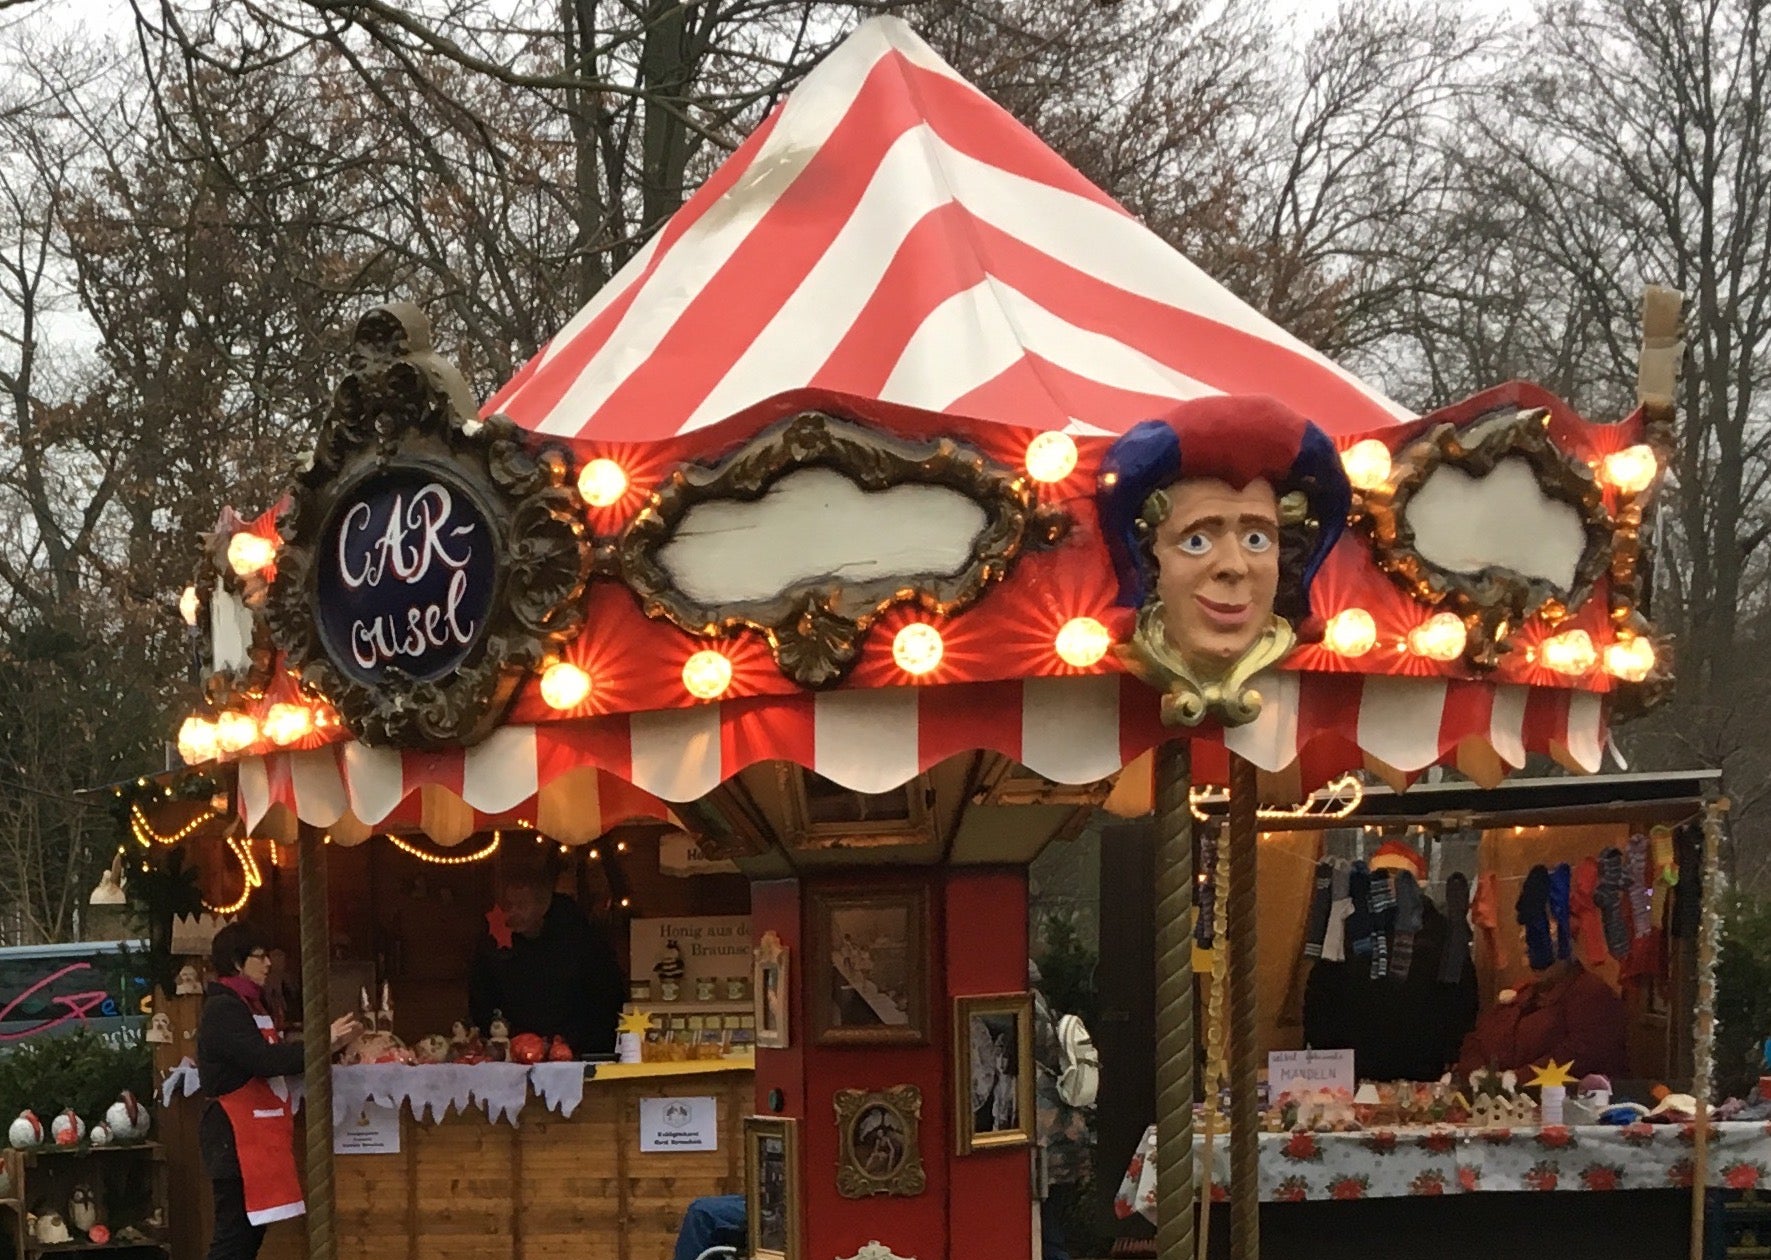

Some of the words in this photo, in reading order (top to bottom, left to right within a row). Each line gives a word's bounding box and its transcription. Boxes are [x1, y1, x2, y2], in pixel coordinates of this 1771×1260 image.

[339, 482, 475, 588] CAR-
[351, 569, 474, 669] ousel
[659, 923, 704, 939] Honig
[707, 926, 733, 937] aus
[691, 943, 750, 957] Braunsc
[1280, 1067, 1337, 1081] MANDELN
